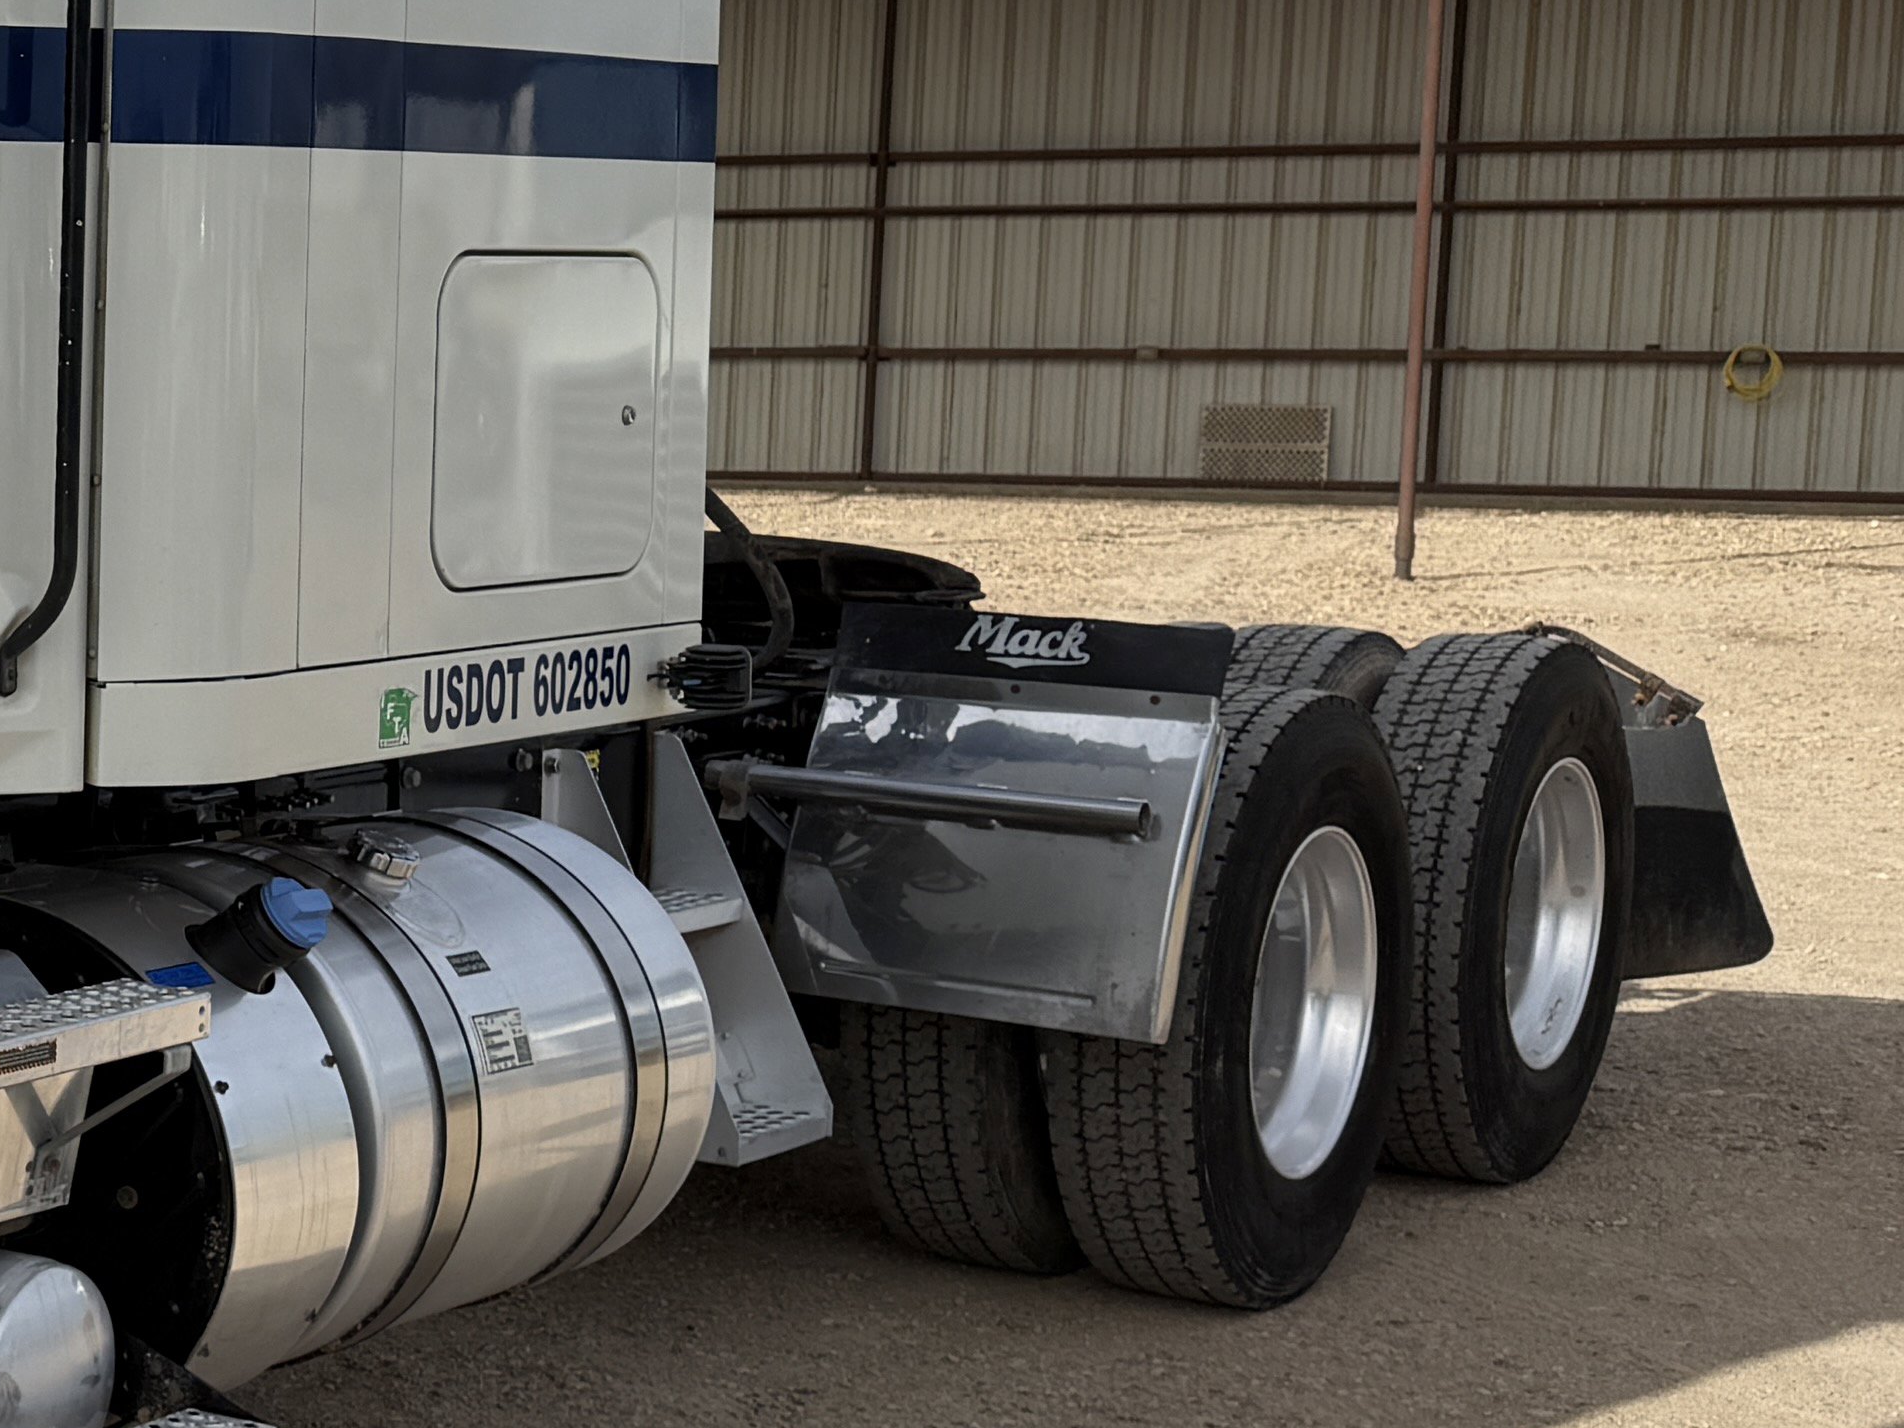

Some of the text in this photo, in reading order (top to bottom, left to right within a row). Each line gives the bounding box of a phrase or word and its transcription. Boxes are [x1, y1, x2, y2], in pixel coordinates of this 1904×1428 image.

[954, 614, 1091, 668] Mack
[423, 643, 631, 734] USDOT 602850
